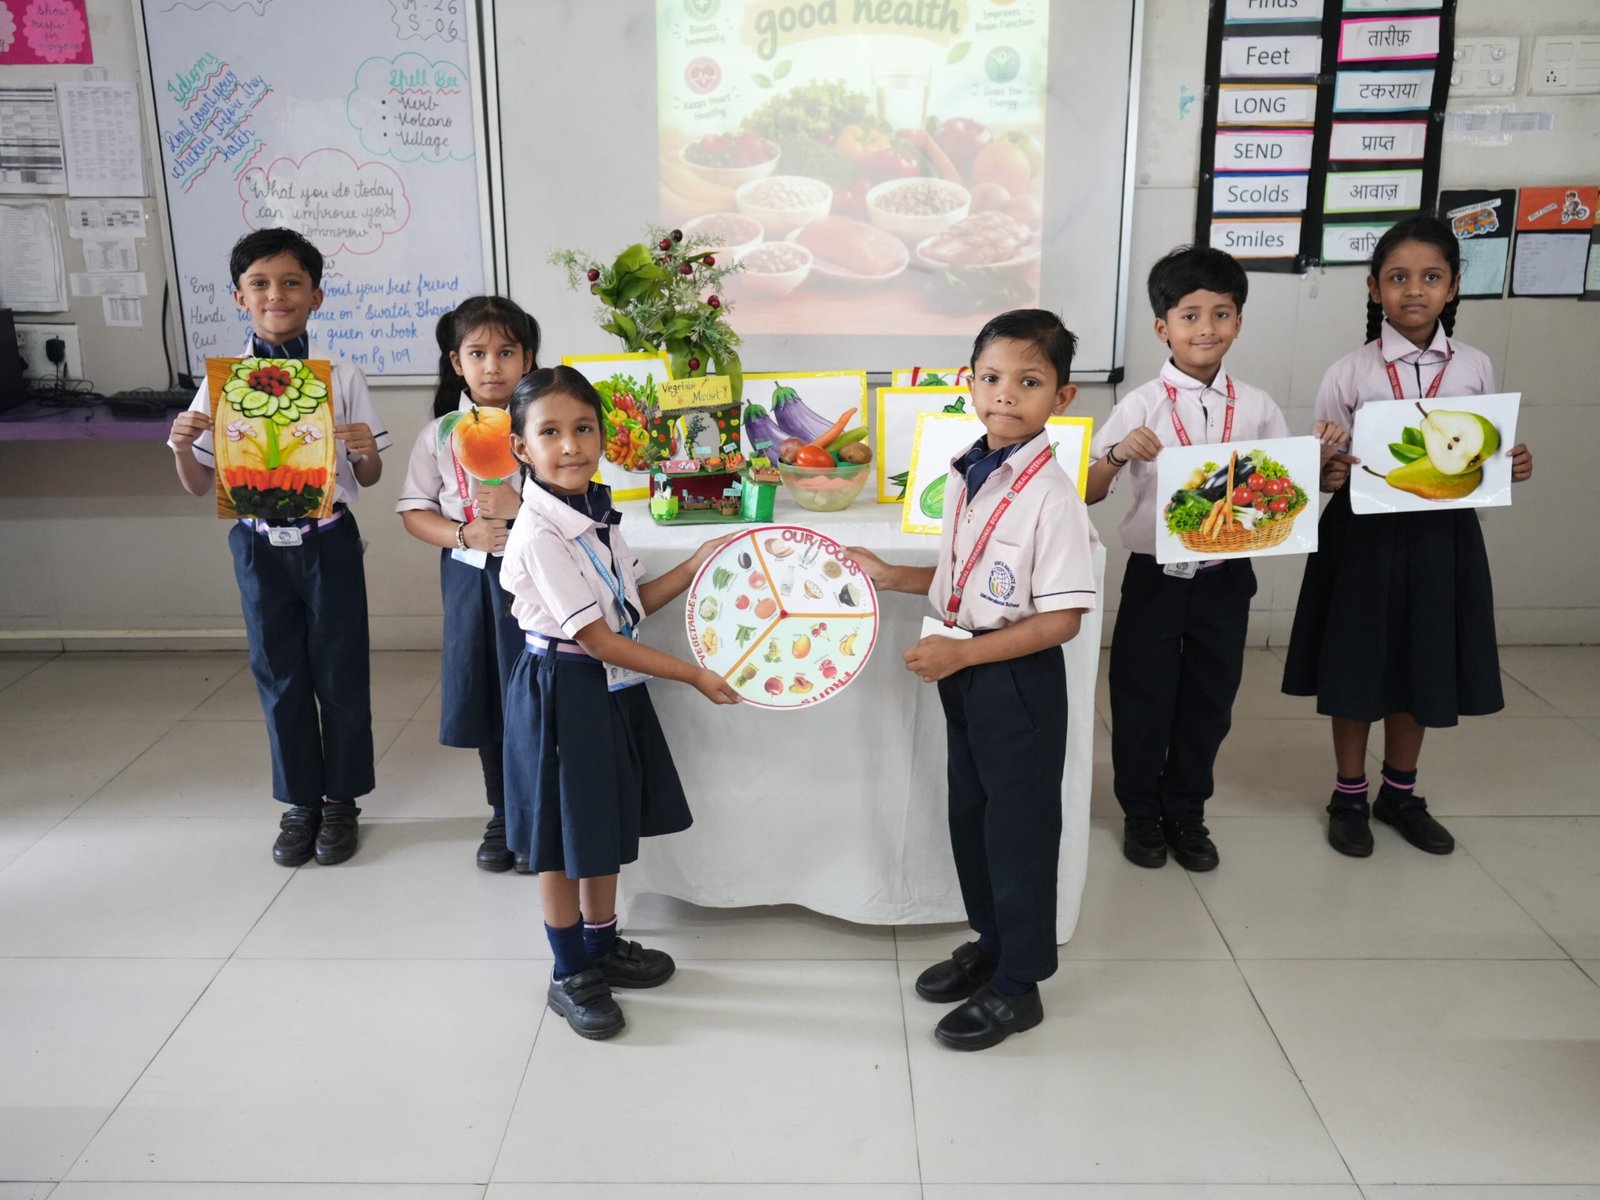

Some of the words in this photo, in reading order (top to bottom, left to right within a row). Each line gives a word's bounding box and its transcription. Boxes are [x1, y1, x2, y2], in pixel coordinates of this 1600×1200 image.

[754, 0, 837, 61] good
[853, 0, 960, 34] health
[1367, 25, 1412, 47] तारीफ़
[1246, 46, 1291, 65] Feet
[168, 52, 219, 102] Idioms
[389, 69, 429, 92] Spell
[434, 70, 460, 88] Bee
[1359, 83, 1419, 99] टकराया
[1234, 97, 1287, 114] LONG
[394, 112, 452, 126] Volcano
[216, 129, 255, 163] hatch
[396, 131, 449, 156] Village
[1234, 143, 1283, 159] SEND
[1361, 136, 1396, 151] प्राप्त
[300, 189, 329, 207] you
[331, 183, 350, 198] do
[1227, 185, 1289, 203] Scolds
[1350, 184, 1399, 201] आवाज़
[256, 206, 284, 219] can
[361, 205, 399, 228] your
[1225, 231, 1284, 247] Smiles
[1349, 232, 1380, 251] बारि
[190, 277, 215, 304] Eng
[323, 280, 353, 297] bout
[355, 281, 385, 302] your
[386, 278, 411, 295] best
[417, 274, 458, 297] friend
[191, 306, 226, 324] Hindi
[340, 310, 353, 319] on
[370, 326, 383, 339] in
[386, 322, 418, 339] book
[352, 352, 368, 364] on
[391, 348, 411, 364] 109
[1013, 473, 1029, 490] IDEAL
[1026, 450, 1050, 475] INTERNATI
[967, 524, 992, 569] INTERNATIONAL
[990, 502, 1007, 525] SCHOOL
[782, 530, 814, 545] OUR
[817, 539, 860, 576] FOODS
[687, 593, 706, 661] VEGETABLES
[801, 671, 852, 704] FRUITS
